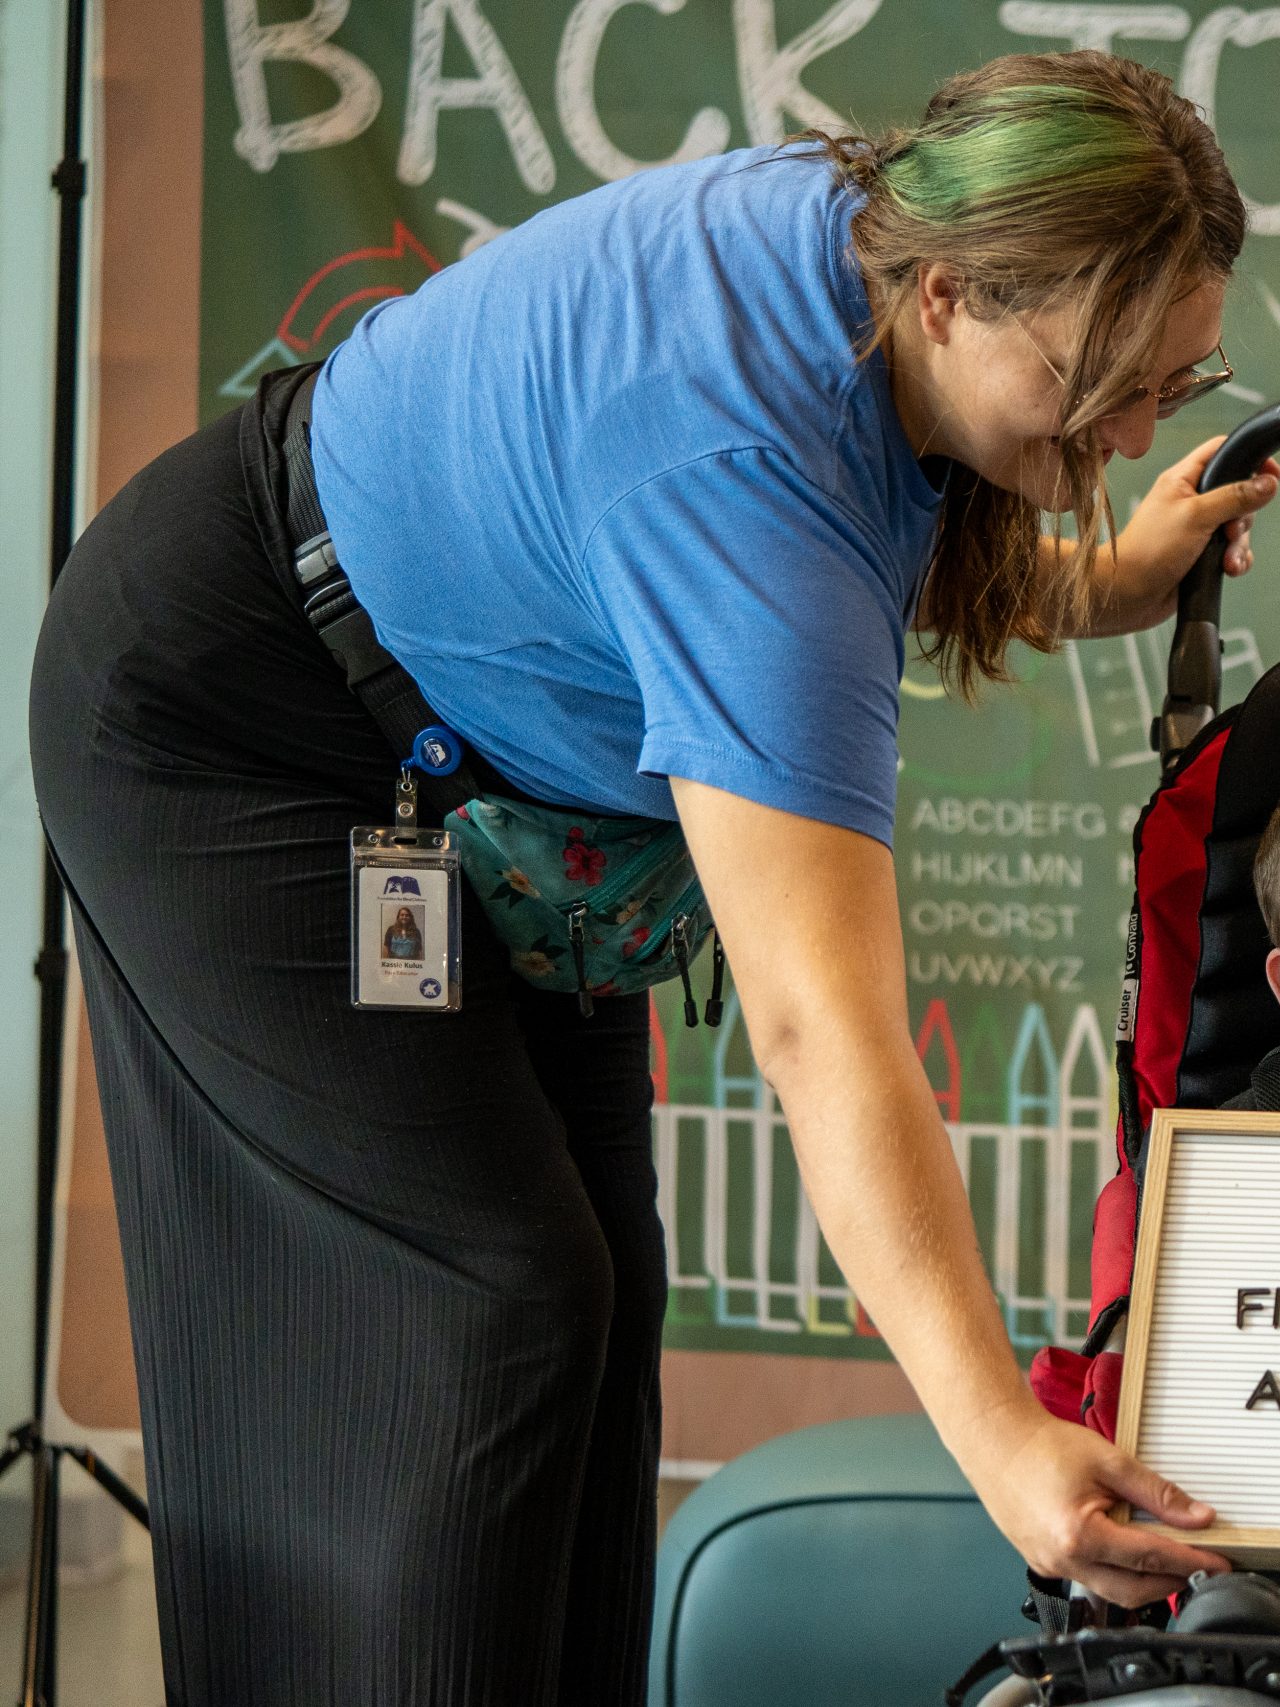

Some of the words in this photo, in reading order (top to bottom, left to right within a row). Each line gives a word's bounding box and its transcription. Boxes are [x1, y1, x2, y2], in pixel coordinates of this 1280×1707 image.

[223, 0, 884, 194] BACK
[911, 797, 1107, 840] ABCDEFG
[911, 950, 1085, 992] UVWXYZ
[1117, 988, 1132, 1032] Cruiser
